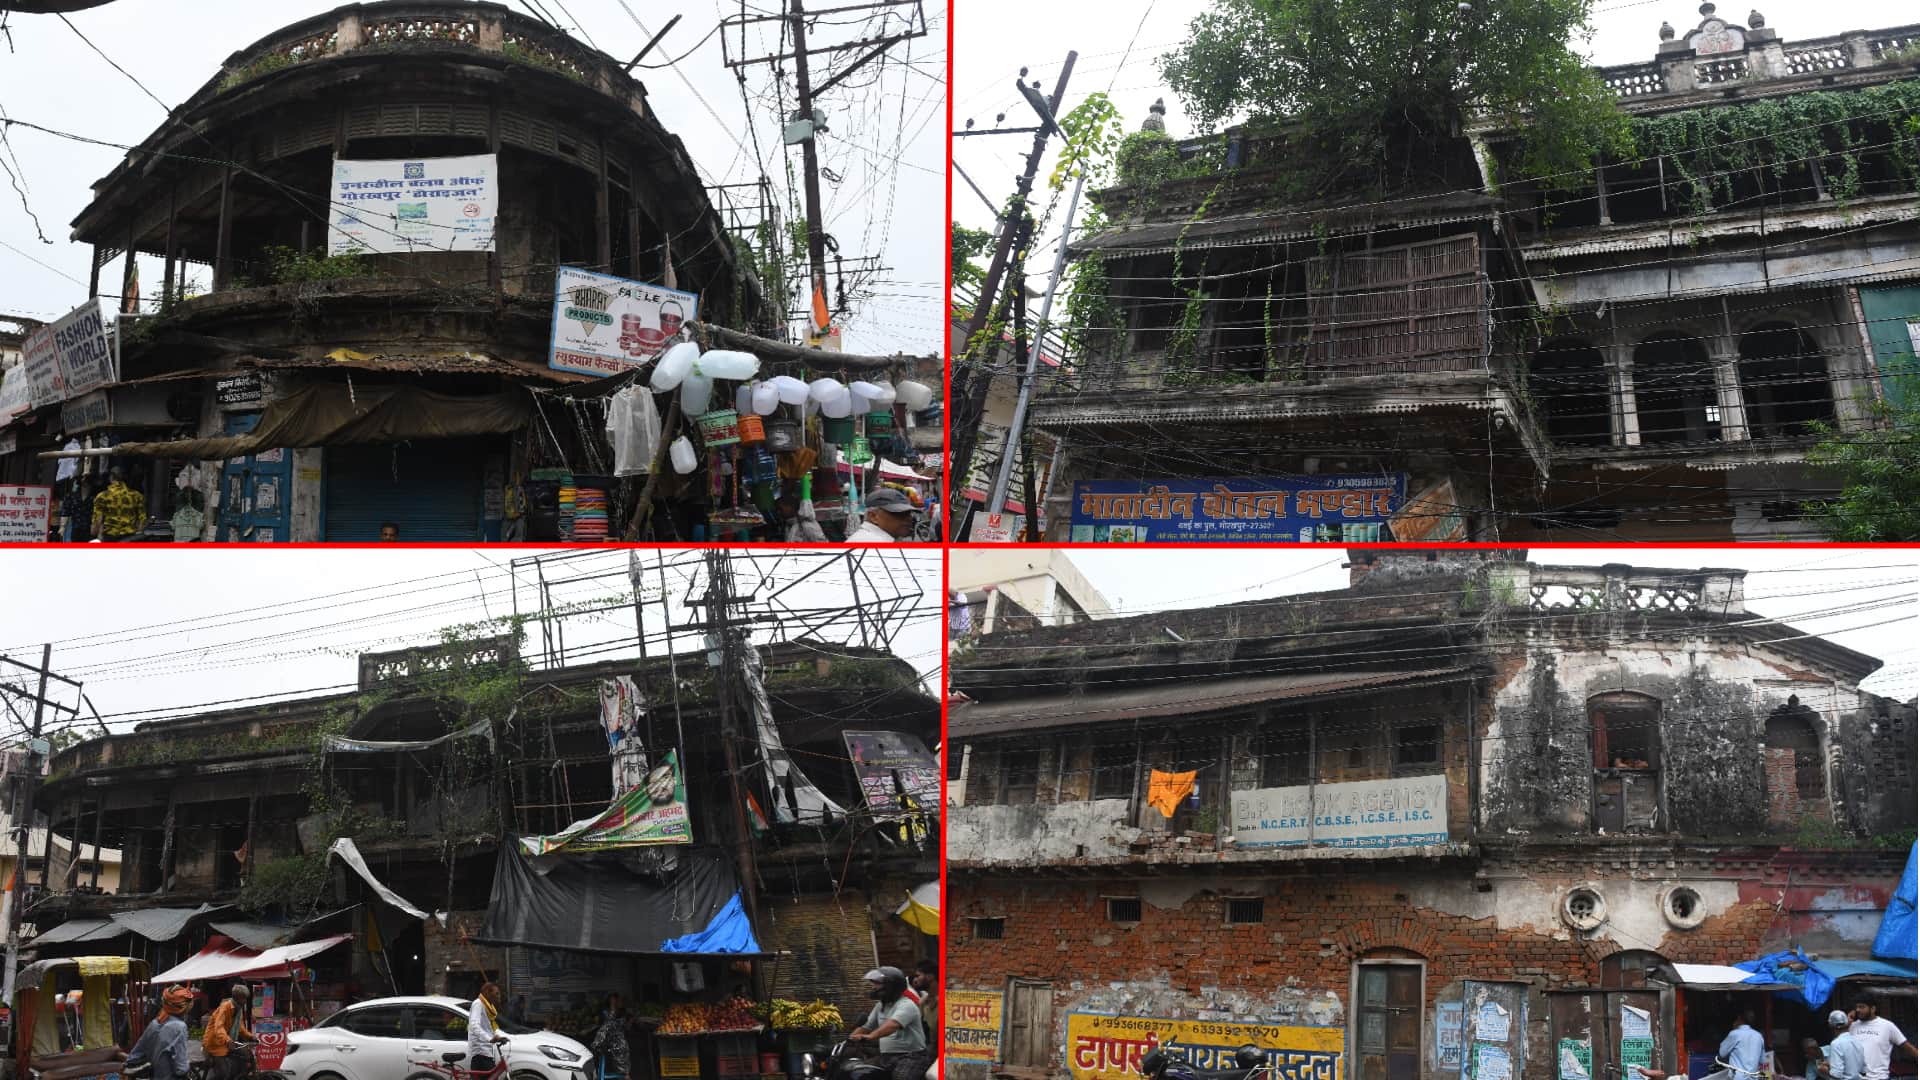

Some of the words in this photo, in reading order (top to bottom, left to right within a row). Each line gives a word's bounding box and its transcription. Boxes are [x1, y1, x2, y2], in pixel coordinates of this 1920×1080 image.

[409, 177, 444, 187] क्लब
[340, 191, 402, 201] गोरखपुर
[574, 287, 609, 311] BHARAT
[568, 308, 610, 323] PRODUCTS
[55, 310, 103, 352] FASHION
[67, 335, 107, 370] WORLD
[1080, 485, 1198, 520] मातादीन
[1200, 484, 1289, 520] बोतल
[1295, 488, 1394, 519] भण्डार
[1350, 785, 1441, 813] AGENCY
[1315, 815, 1358, 827] C.B.S.E.,
[1361, 811, 1402, 823] I.C.S.E.,
[1404, 810, 1433, 822] I.S.C.
[951, 1000, 992, 1025] टापर्स
[1106, 1020, 1173, 1032] 9936168377
[1074, 1032, 1161, 1073] टापर्स
